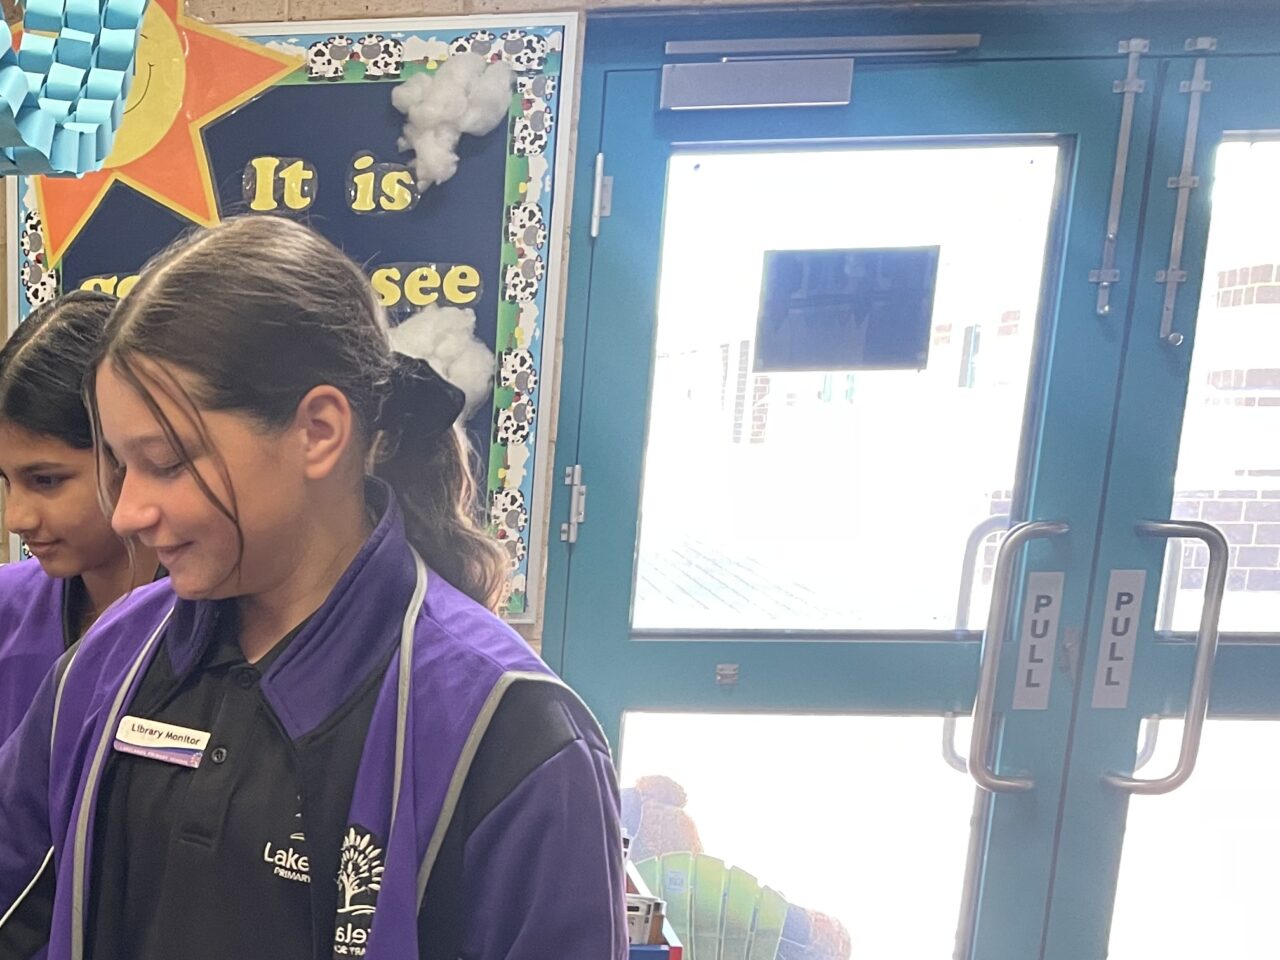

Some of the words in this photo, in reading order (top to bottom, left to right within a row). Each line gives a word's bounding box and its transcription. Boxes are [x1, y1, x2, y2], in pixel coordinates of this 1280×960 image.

[250, 156, 315, 210] It
[351, 155, 415, 212] is
[371, 263, 482, 306] see
[1025, 594, 1053, 688] PULL
[1104, 591, 1134, 687] PULL
[131, 723, 164, 739] Library
[165, 731, 201, 746] Monitor
